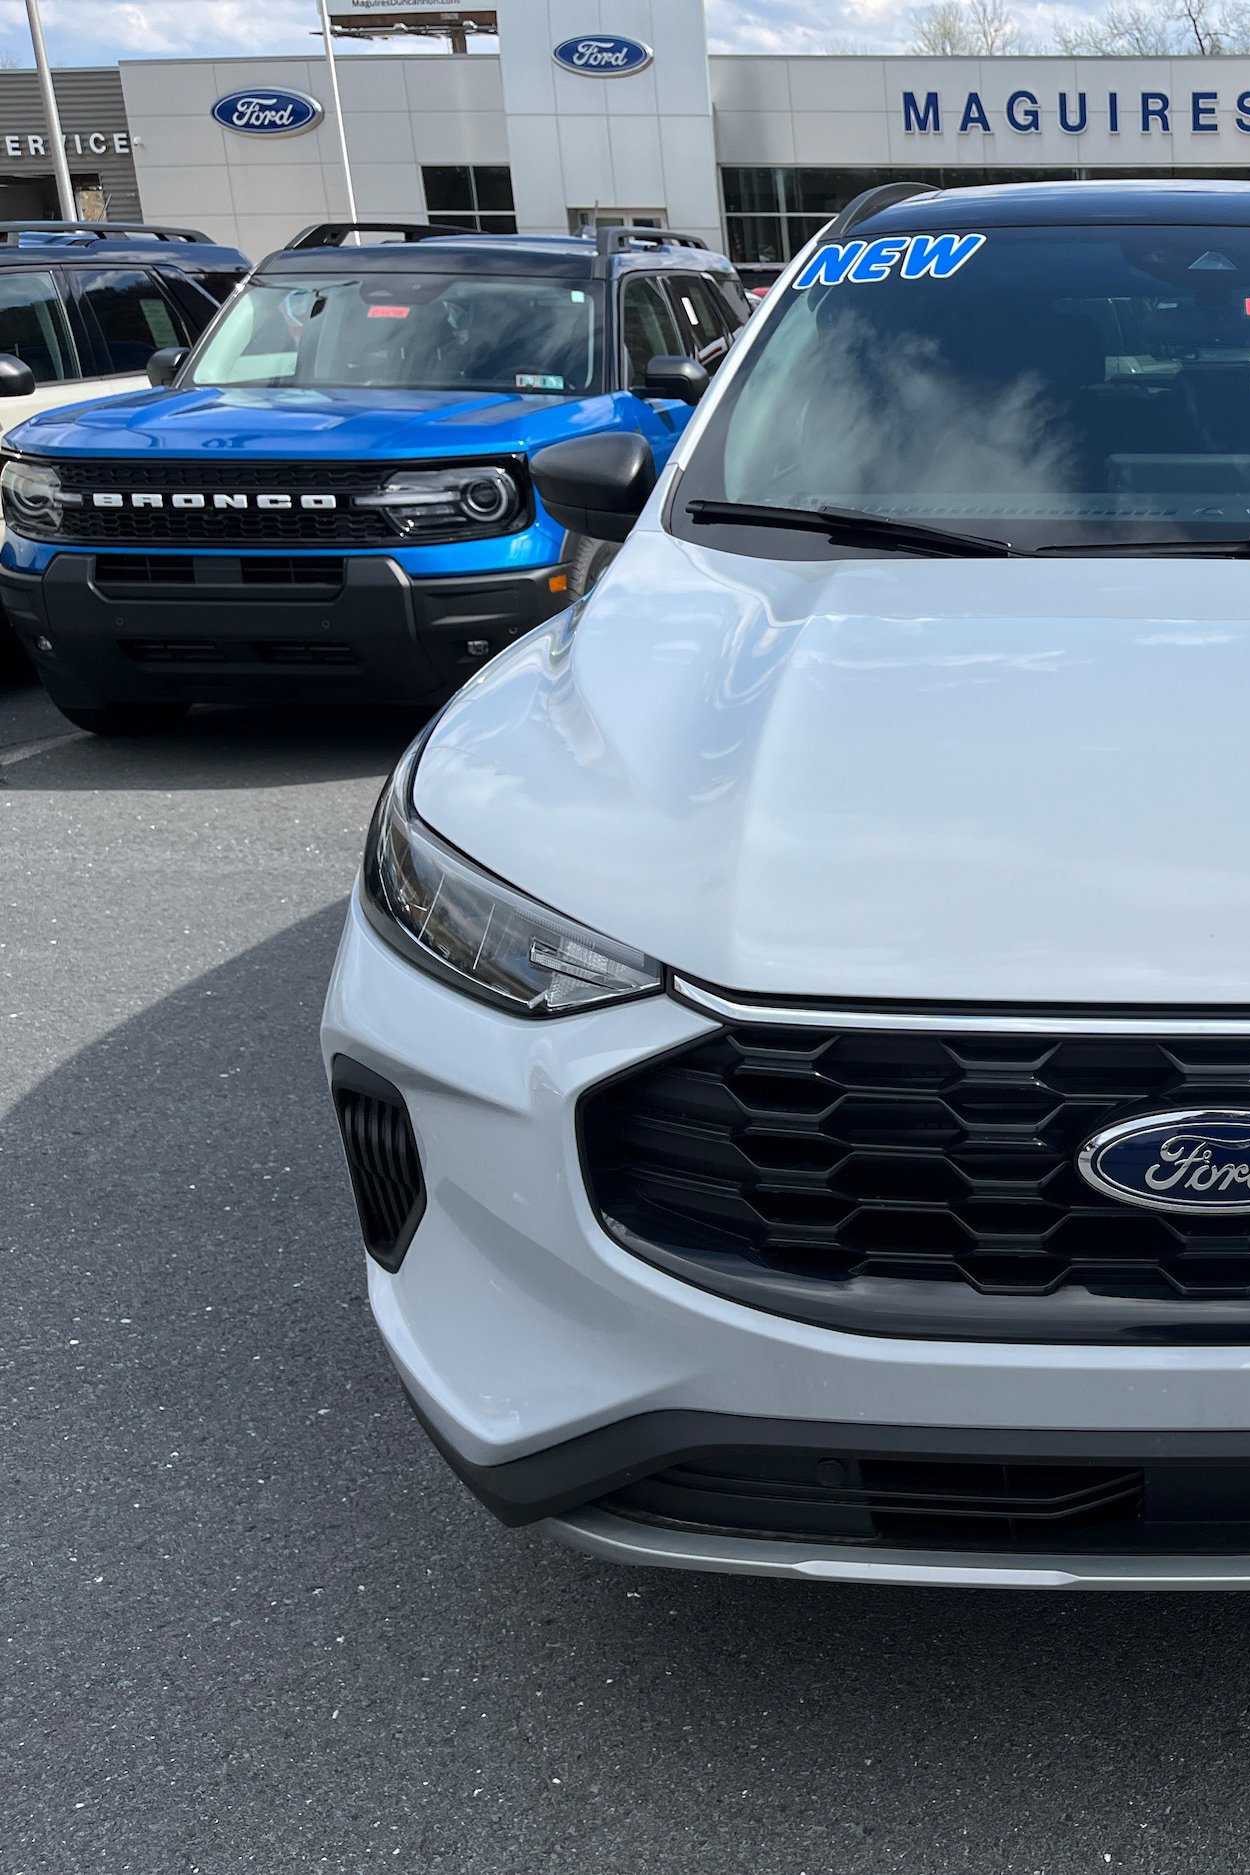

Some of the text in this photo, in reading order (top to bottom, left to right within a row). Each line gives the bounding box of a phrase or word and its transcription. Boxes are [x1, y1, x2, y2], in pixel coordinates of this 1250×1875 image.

[573, 41, 628, 66] Ford
[232, 97, 294, 126] Ford
[792, 233, 987, 290] NEW
[92, 493, 337, 509] BRONCO
